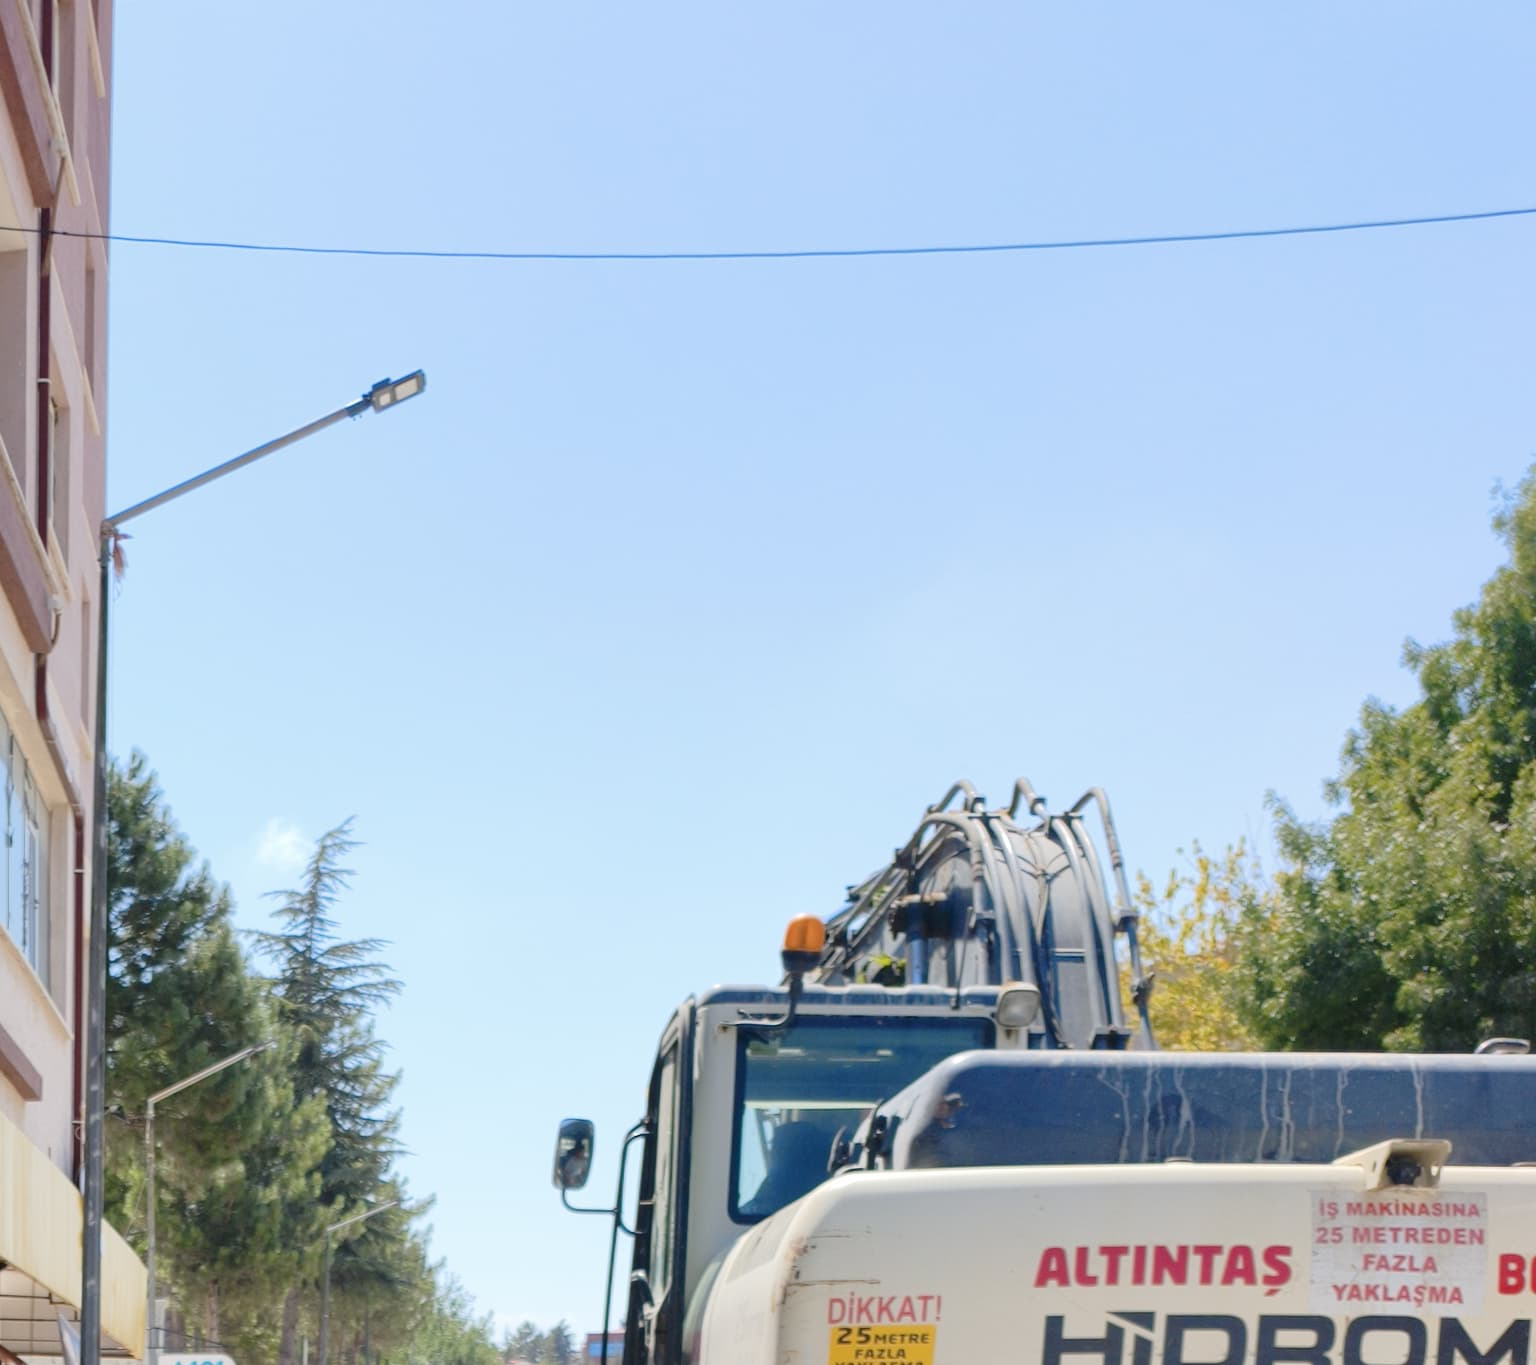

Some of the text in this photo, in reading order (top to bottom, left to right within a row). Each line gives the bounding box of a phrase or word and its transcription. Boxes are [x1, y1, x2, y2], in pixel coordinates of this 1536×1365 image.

[1319, 1199, 1481, 1219] İŞ MAKİNASINA
[1315, 1227, 1485, 1246] 25 METREDEN
[1034, 1244, 1294, 1297] ALTINTAŞ
[1362, 1254, 1438, 1273] FAZLA
[1332, 1284, 1464, 1307] YAKLAŞMA
[827, 1291, 942, 1324] DİKKAT!
[837, 1327, 930, 1345] 25 METRE
[854, 1348, 907, 1360] FAZLA
